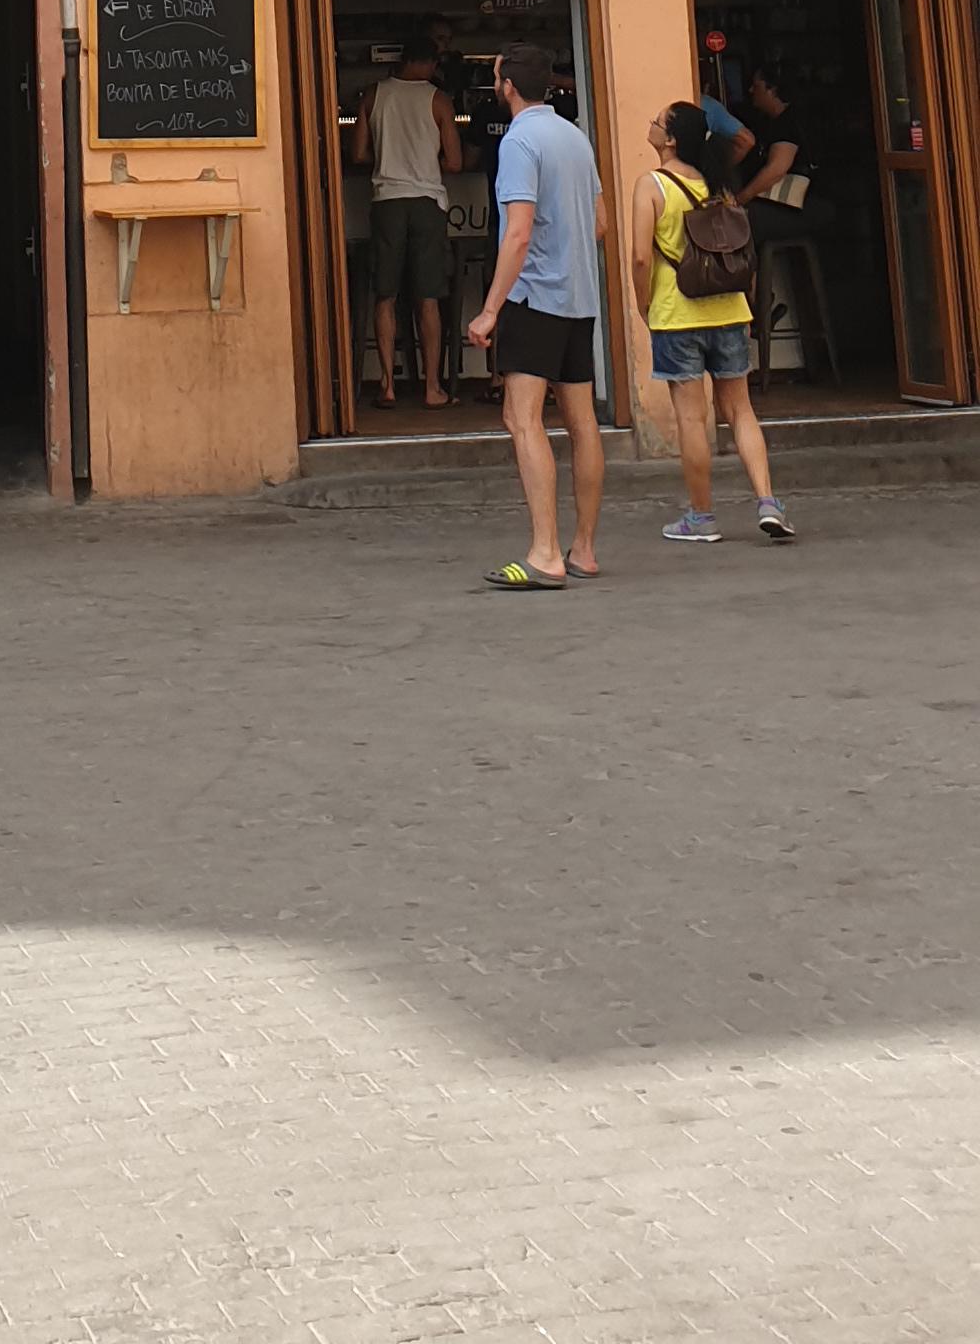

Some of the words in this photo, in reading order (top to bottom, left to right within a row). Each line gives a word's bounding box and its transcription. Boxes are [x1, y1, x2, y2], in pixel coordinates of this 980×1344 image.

[137, 3, 154, 21] DE
[107, 51, 125, 70] LA
[126, 48, 191, 71] TASQUITA
[198, 46, 231, 67] MAS
[106, 81, 155, 103] BONITA
[160, 83, 179, 101] DE
[183, 78, 237, 101] EUROPA
[168, 112, 195, 131] 107
